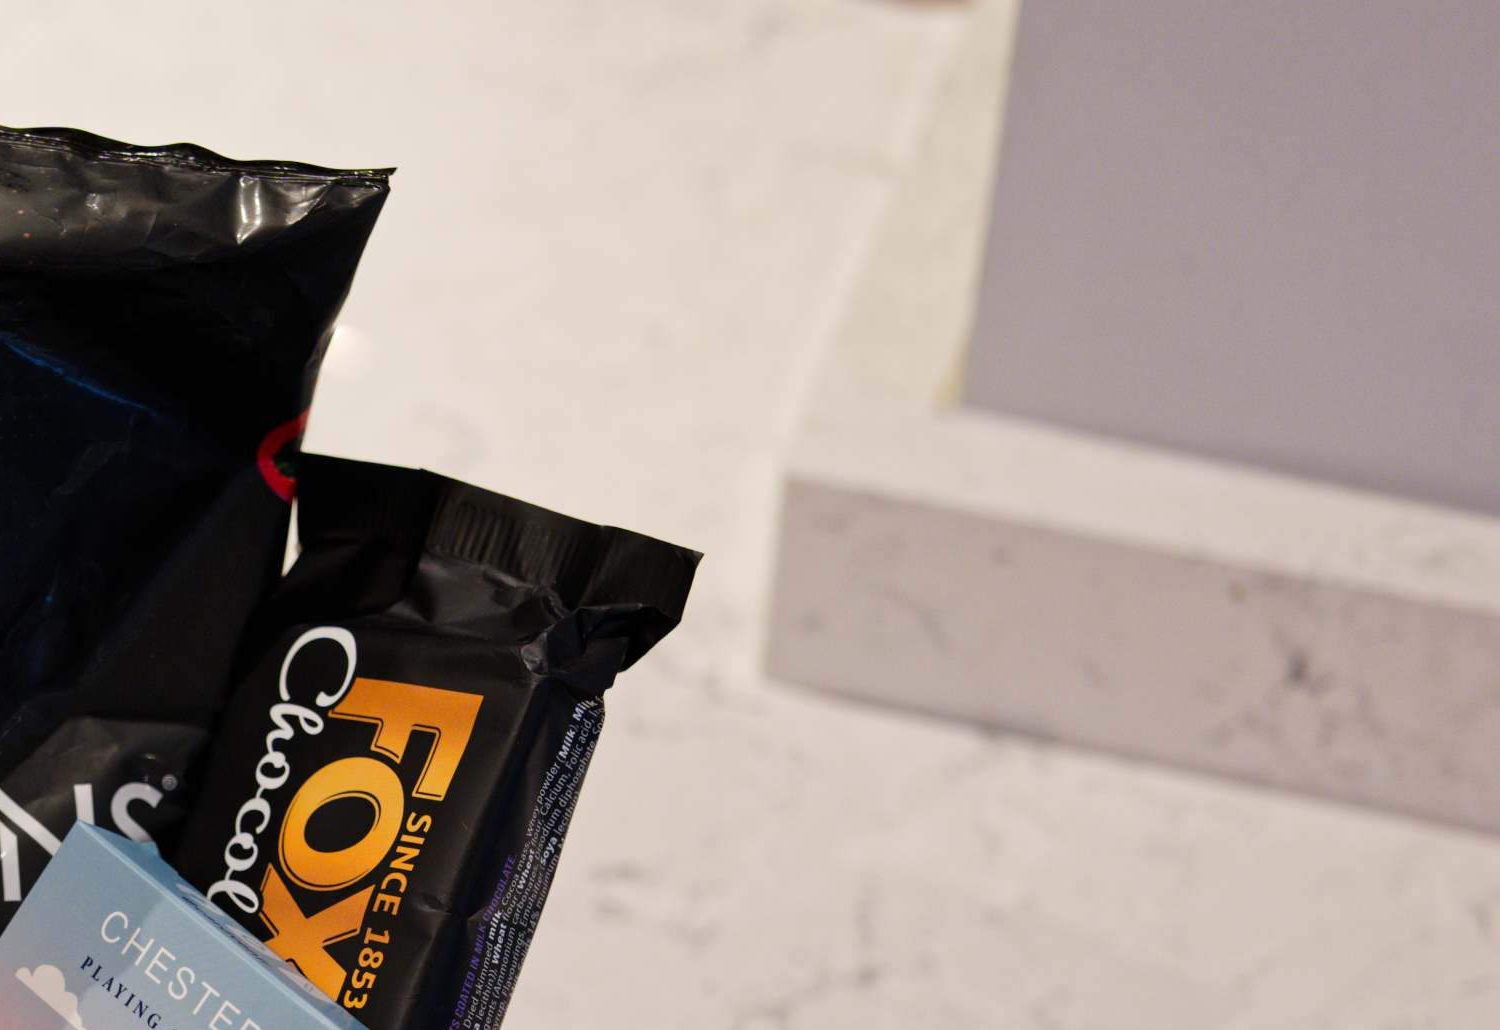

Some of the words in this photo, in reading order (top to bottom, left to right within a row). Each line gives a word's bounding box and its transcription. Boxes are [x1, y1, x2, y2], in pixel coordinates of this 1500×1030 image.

[206, 626, 357, 913] Chocol
[259, 677, 484, 1001] FOX
[372, 812, 433, 917] SINCE
[462, 996, 479, 1028] Dried
[472, 941, 494, 996] skimmed
[500, 873, 519, 905] Cocoa
[535, 761, 561, 804] powder
[571, 697, 598, 721] Milk
[490, 921, 507, 964] Wheat
[502, 895, 518, 921] flour
[514, 848, 536, 894] (Wheat
[539, 770, 571, 815] Calcium,
[564, 743, 584, 769] Folic
[576, 716, 595, 743] acid,
[80, 956, 161, 1029] PLAYING
[344, 926, 390, 1008] 1853
[492, 926, 516, 998] (Ammonium
[533, 807, 561, 860] Disodium
